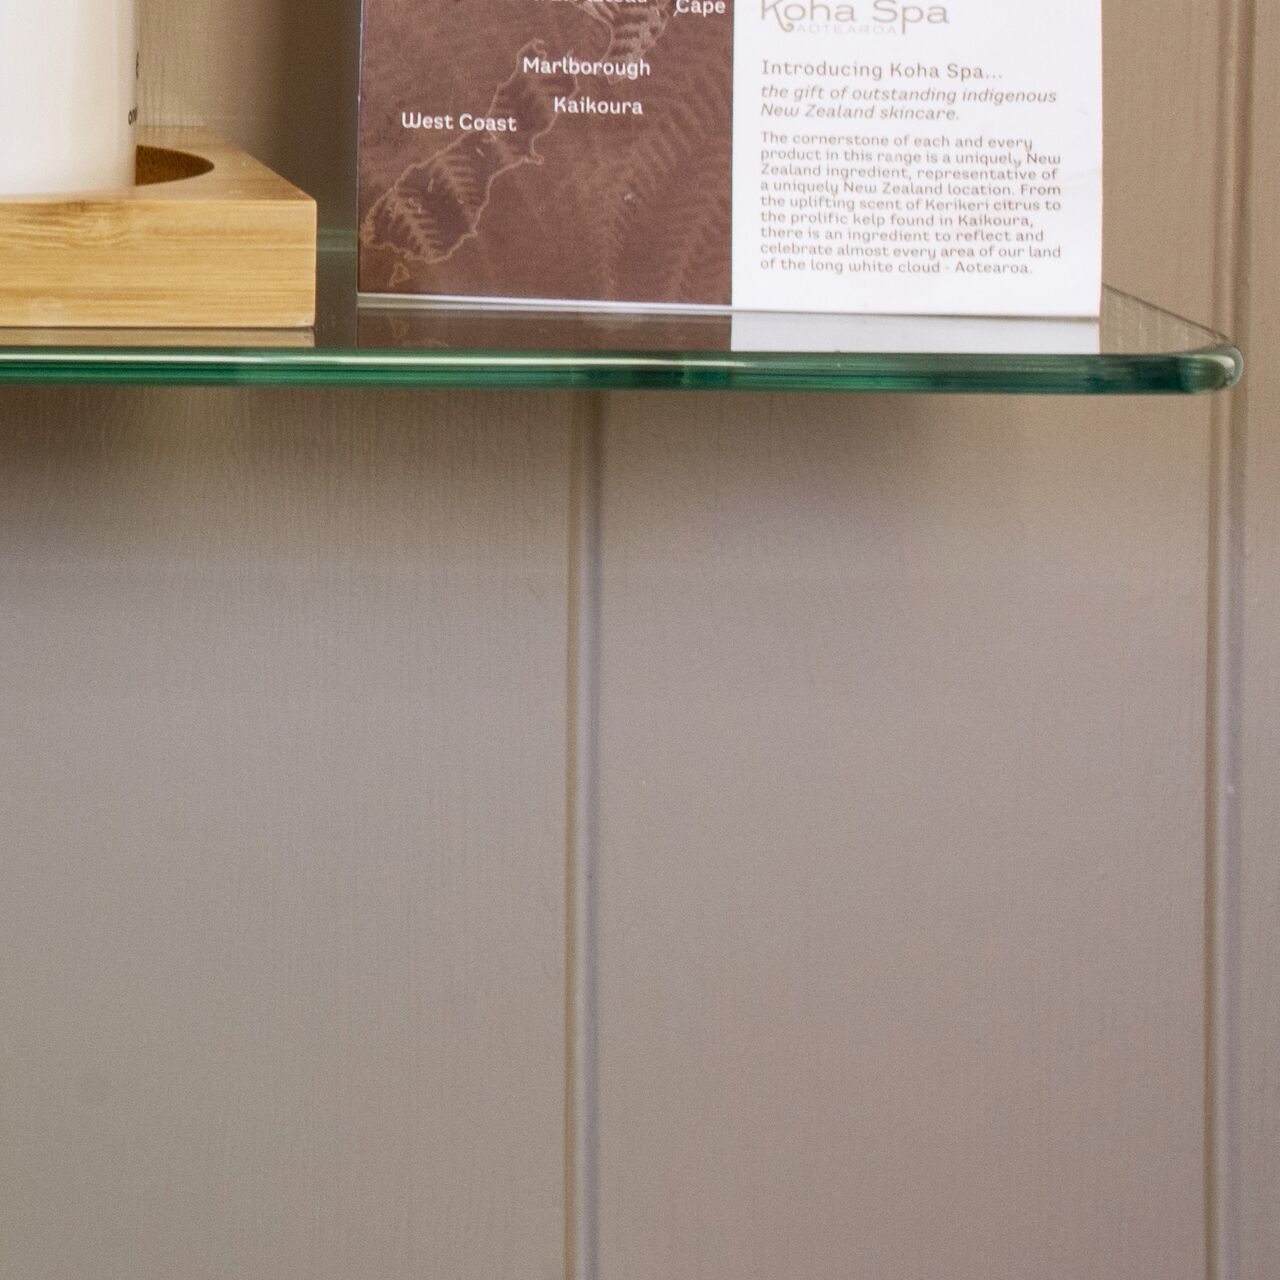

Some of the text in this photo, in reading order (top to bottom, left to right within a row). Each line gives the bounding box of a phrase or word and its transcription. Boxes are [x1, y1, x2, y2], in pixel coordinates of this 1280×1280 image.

[523, 57, 651, 78] Marlborough
[762, 60, 882, 80] Introducing
[890, 63, 940, 79] Koha
[761, 86, 1057, 106] the gift of outstanding indigenous
[554, 97, 643, 116] Kaikoura
[761, 103, 959, 120] New Zealand skincare.
[402, 112, 516, 132] West Coast
[761, 132, 1033, 151] The cornerstone of each and every
[761, 147, 1061, 167] product in this range is a uniquely New
[761, 163, 1058, 182] Zealand ingredient, representative of
[761, 180, 1061, 196] a uniquely New Zealand location. From
[761, 196, 1061, 211] the uplifting scent of Kerikeri citrus to
[761, 211, 1034, 229] the prolific kelp found in Kaikoura,
[761, 227, 1044, 244] there is an ingredient to reflect and
[760, 243, 1061, 260] celebrate almost every area of our land
[760, 258, 777, 270] of
[781, 259, 806, 271] the
[811, 259, 843, 275] long
[848, 261, 893, 273] white
[898, 261, 940, 273] cloud
[955, 262, 1032, 274] Aotearoa.
